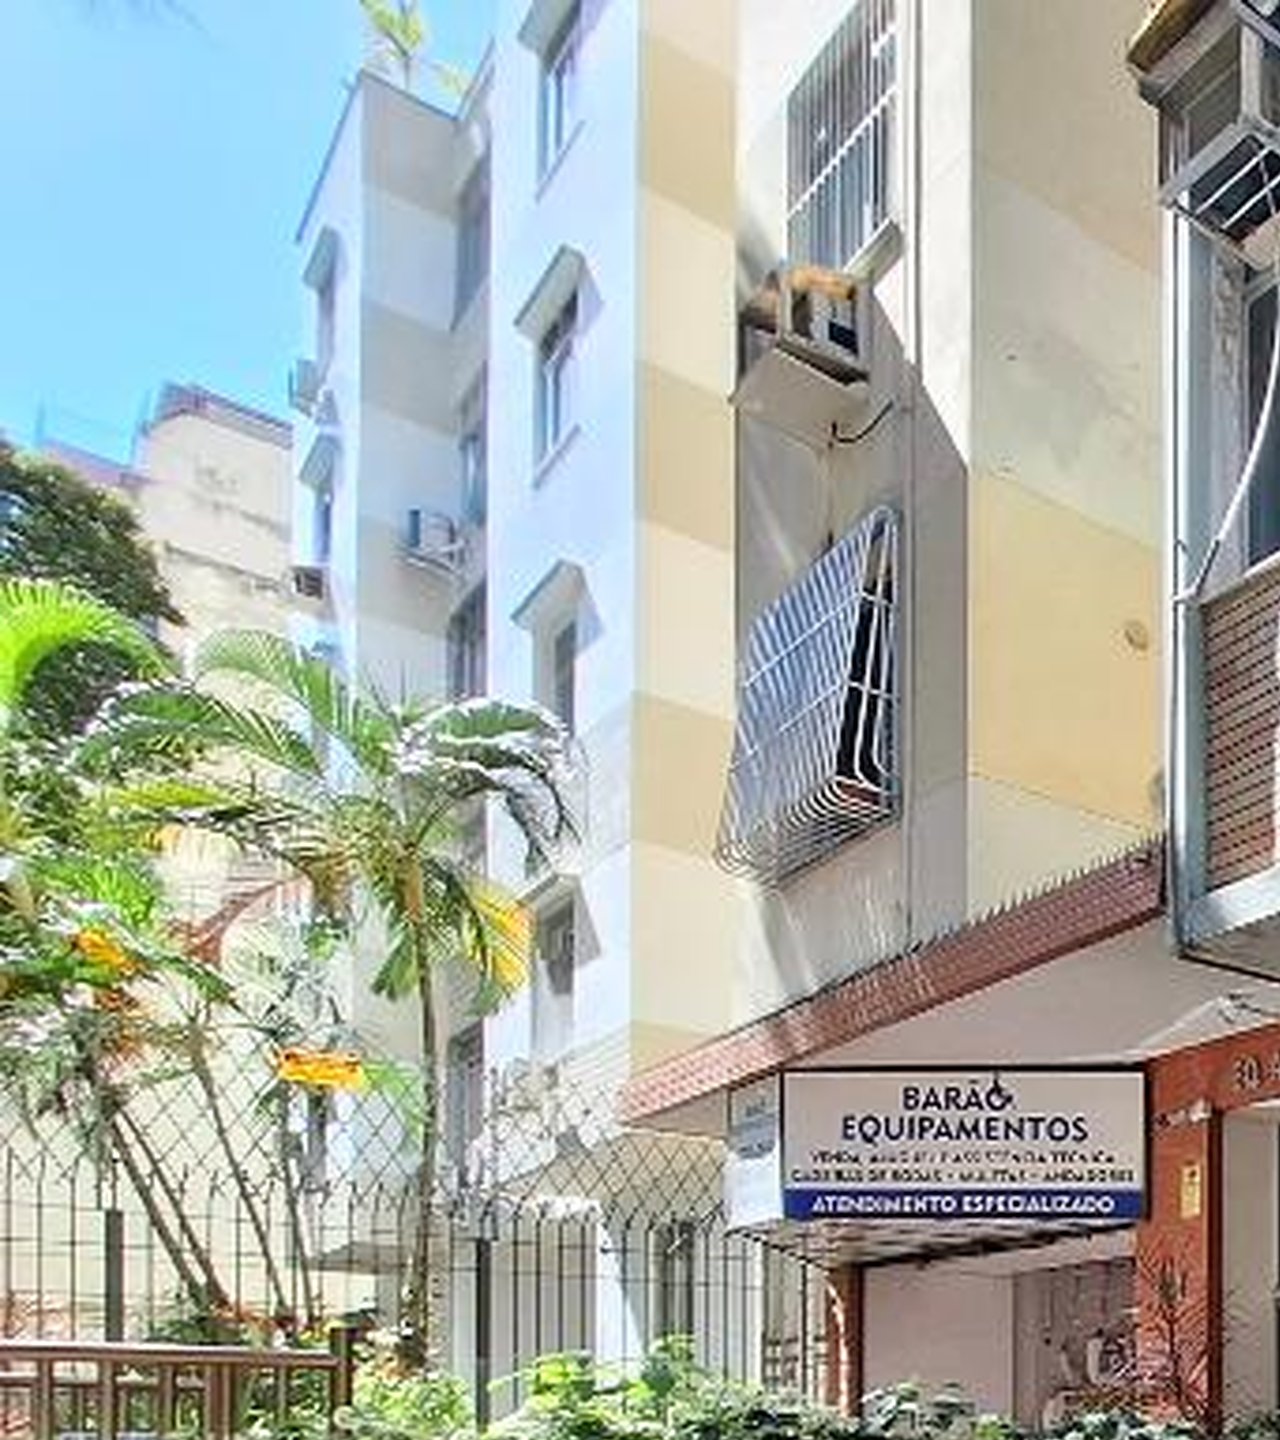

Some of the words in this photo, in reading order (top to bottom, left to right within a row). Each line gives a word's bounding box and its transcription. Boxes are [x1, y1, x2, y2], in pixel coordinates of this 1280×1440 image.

[841, 1115, 1089, 1144] EQUIPAMENTOS
[811, 1194, 957, 1214] ATENDIMENTO
[962, 1194, 1115, 1214] ESPECIALIZADO
